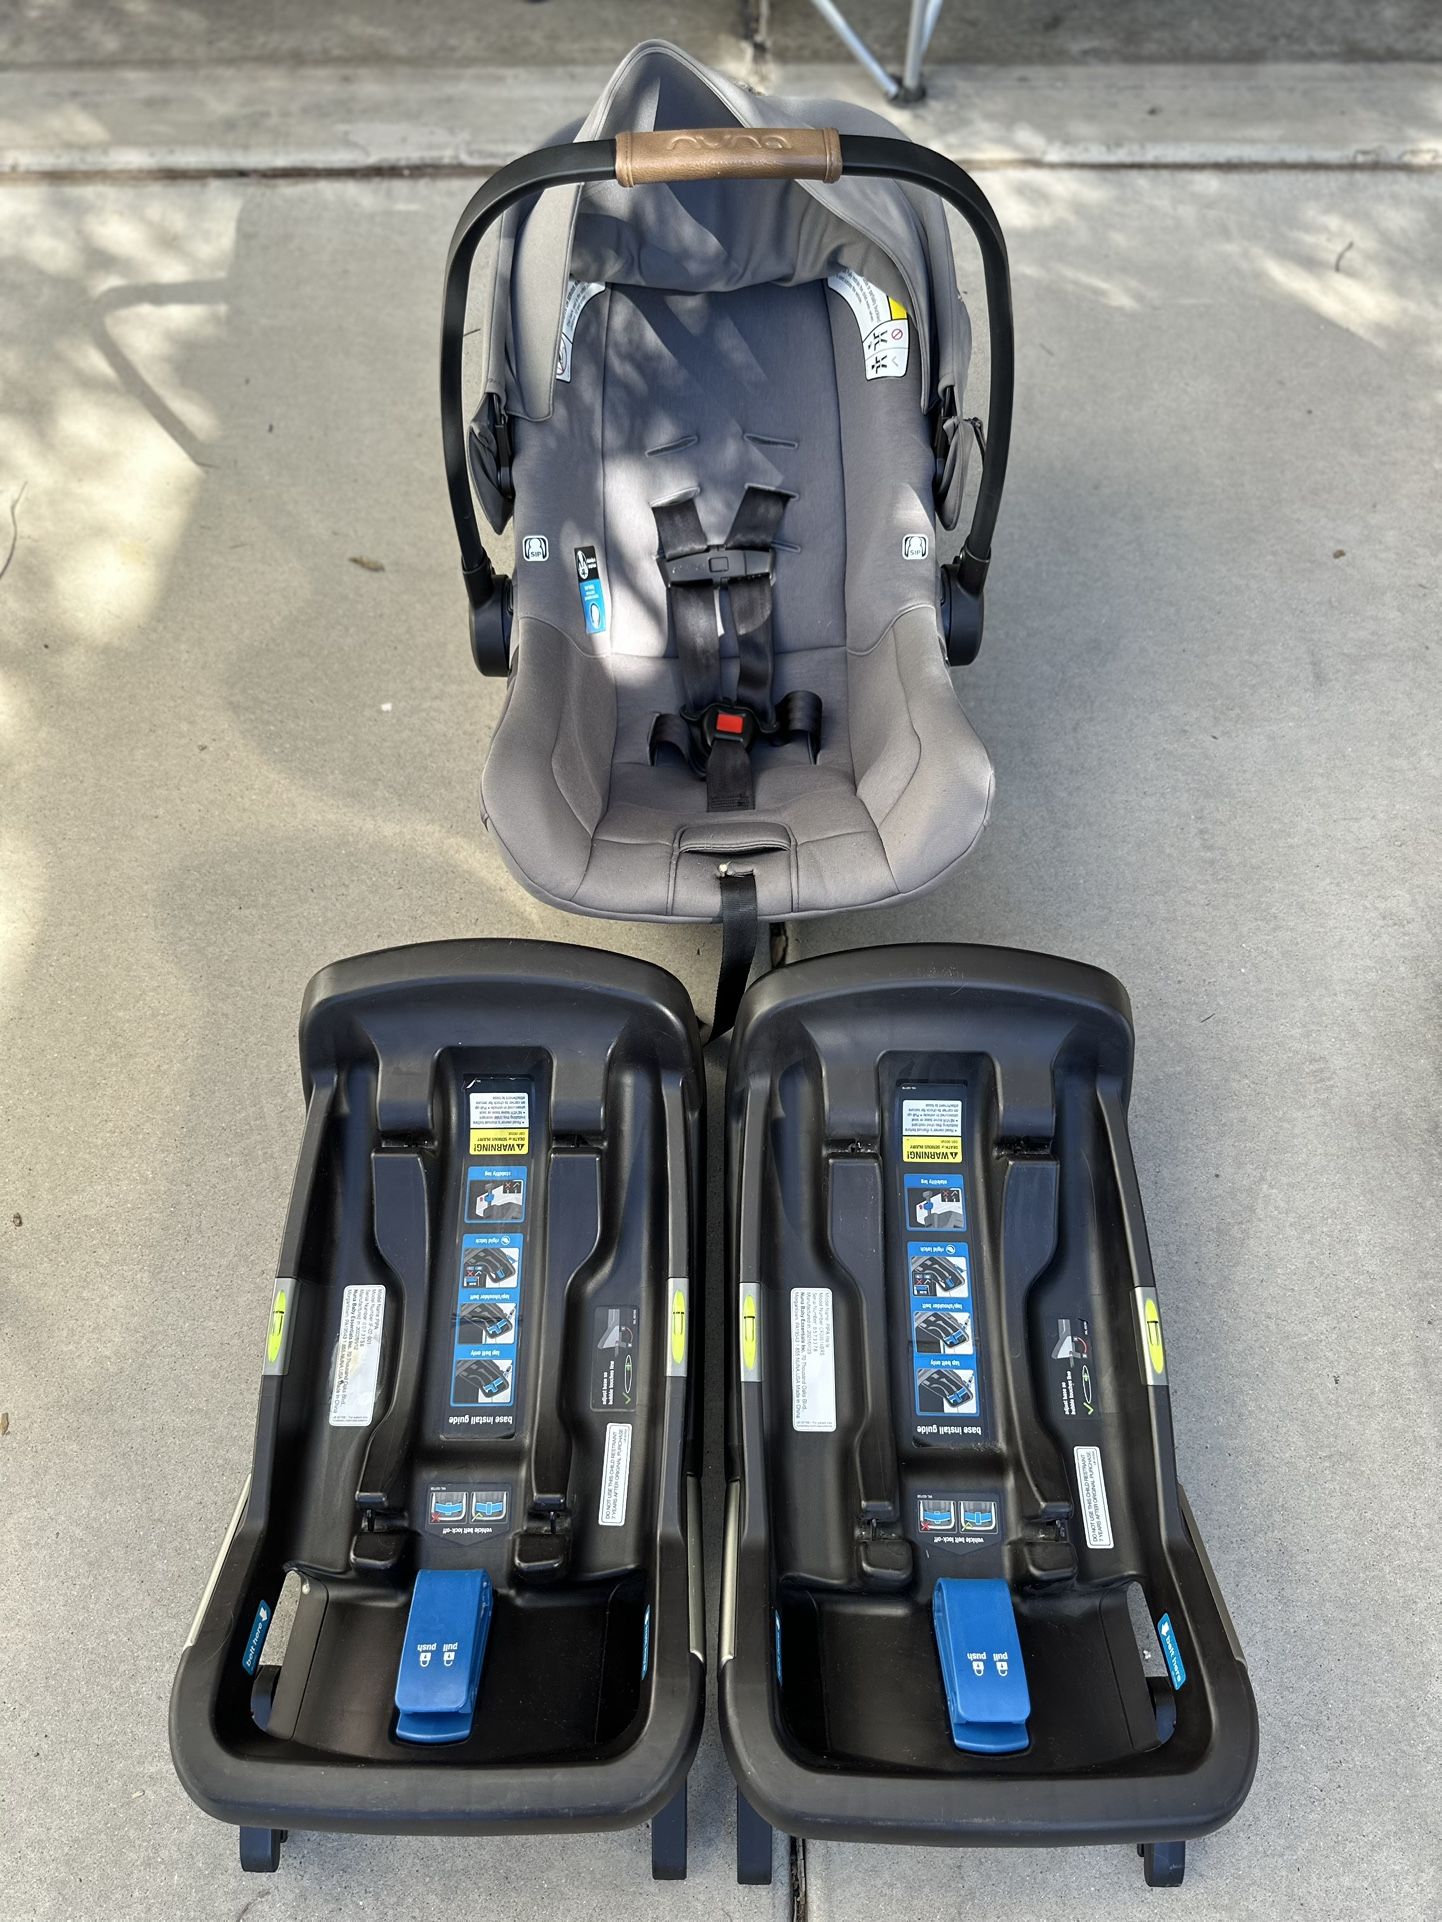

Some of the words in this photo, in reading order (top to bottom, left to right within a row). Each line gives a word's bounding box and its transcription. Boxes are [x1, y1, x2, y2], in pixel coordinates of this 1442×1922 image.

[667, 134, 791, 150] nuna
[907, 1151, 949, 1159] WARNING!
[449, 1415, 469, 1425] guide
[471, 1416, 493, 1424] install
[495, 1416, 512, 1424] base
[917, 1424, 937, 1434] guide
[939, 1426, 962, 1435] install
[964, 1427, 981, 1435] base
[1081, 1454, 1089, 1481] RESTRAINT
[1090, 1480, 1098, 1503] ORIGINAL
[606, 1511, 611, 1519] DO
[1092, 1534, 1098, 1542] DO
[246, 1645, 256, 1667] belt
[252, 1622, 263, 1645] here
[417, 1643, 437, 1652] push
[443, 1642, 458, 1652] pull
[967, 1652, 987, 1661] push
[993, 1652, 1008, 1661] pull
[1166, 1635, 1175, 1657] belt
[1172, 1657, 1182, 1681] here
